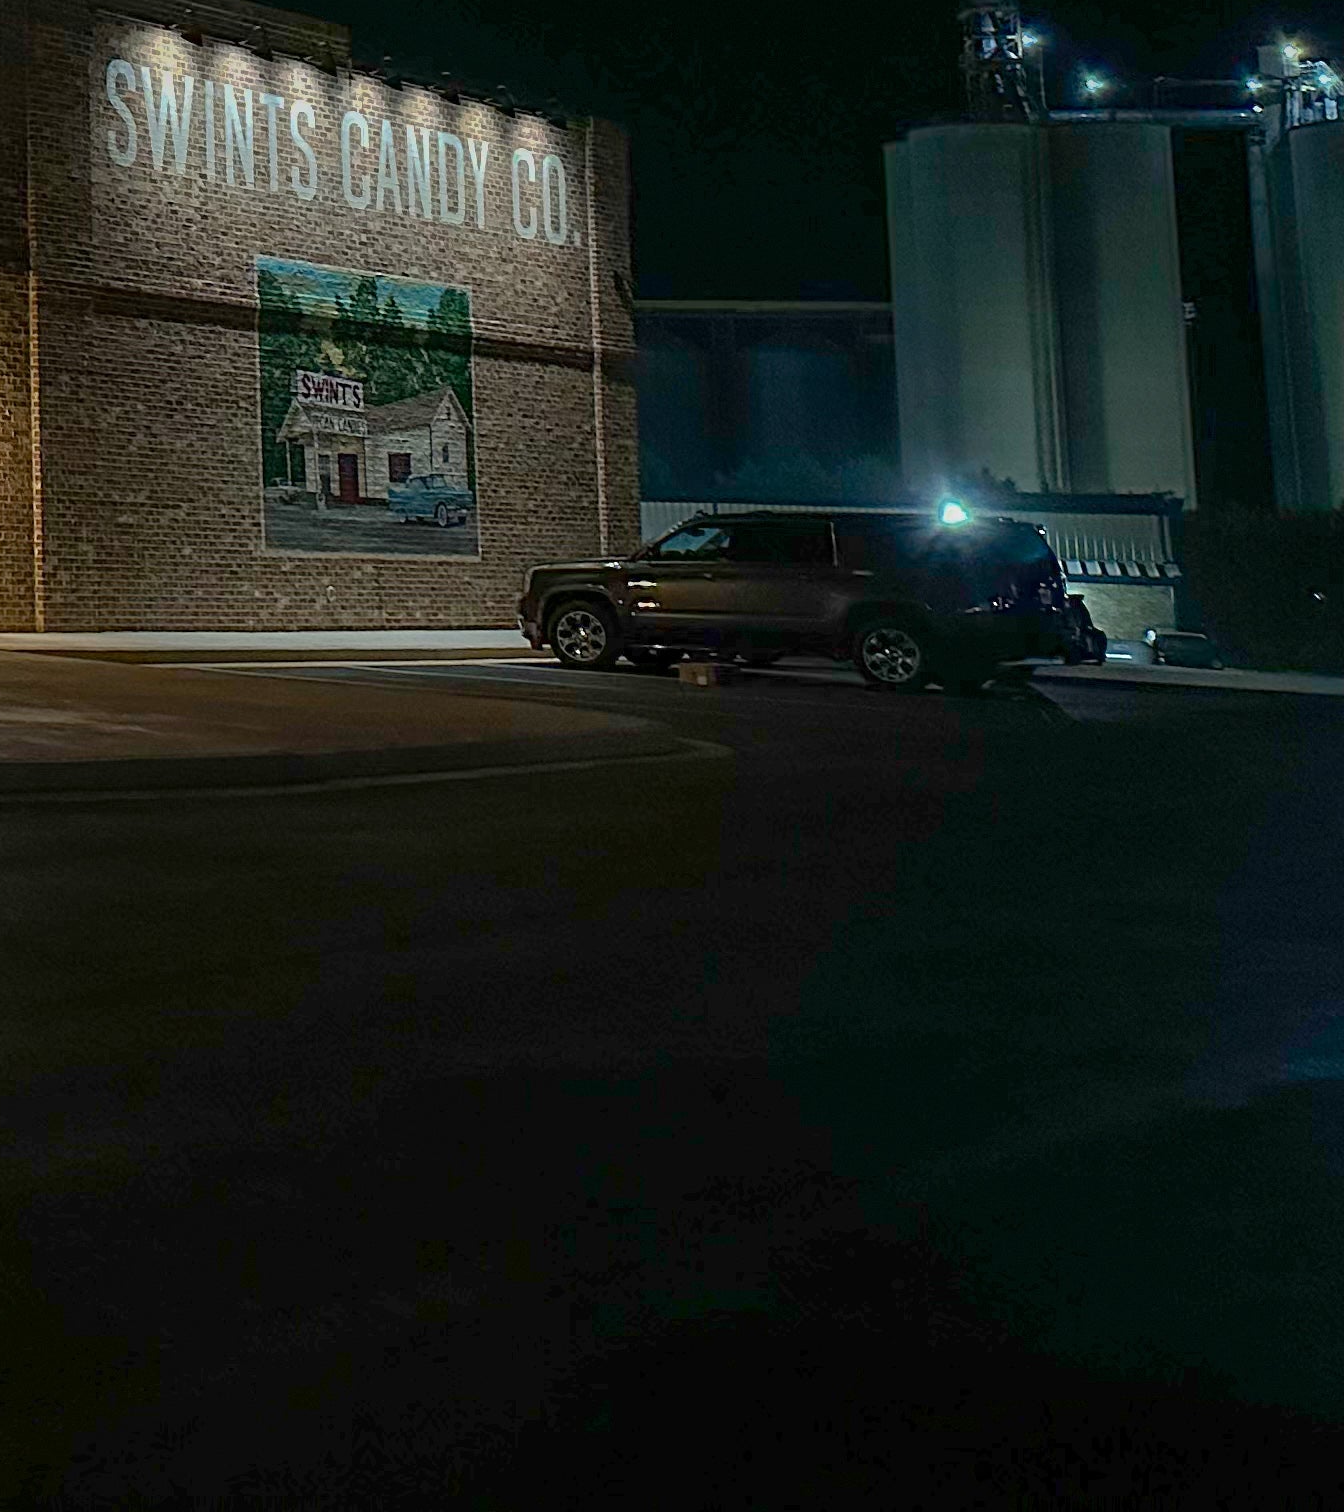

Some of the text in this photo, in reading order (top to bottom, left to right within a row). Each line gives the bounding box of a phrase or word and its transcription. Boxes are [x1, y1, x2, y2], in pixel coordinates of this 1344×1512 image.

[106, 58, 582, 247] SWINTS CANDY CO.
[301, 373, 361, 408] SWINTS
